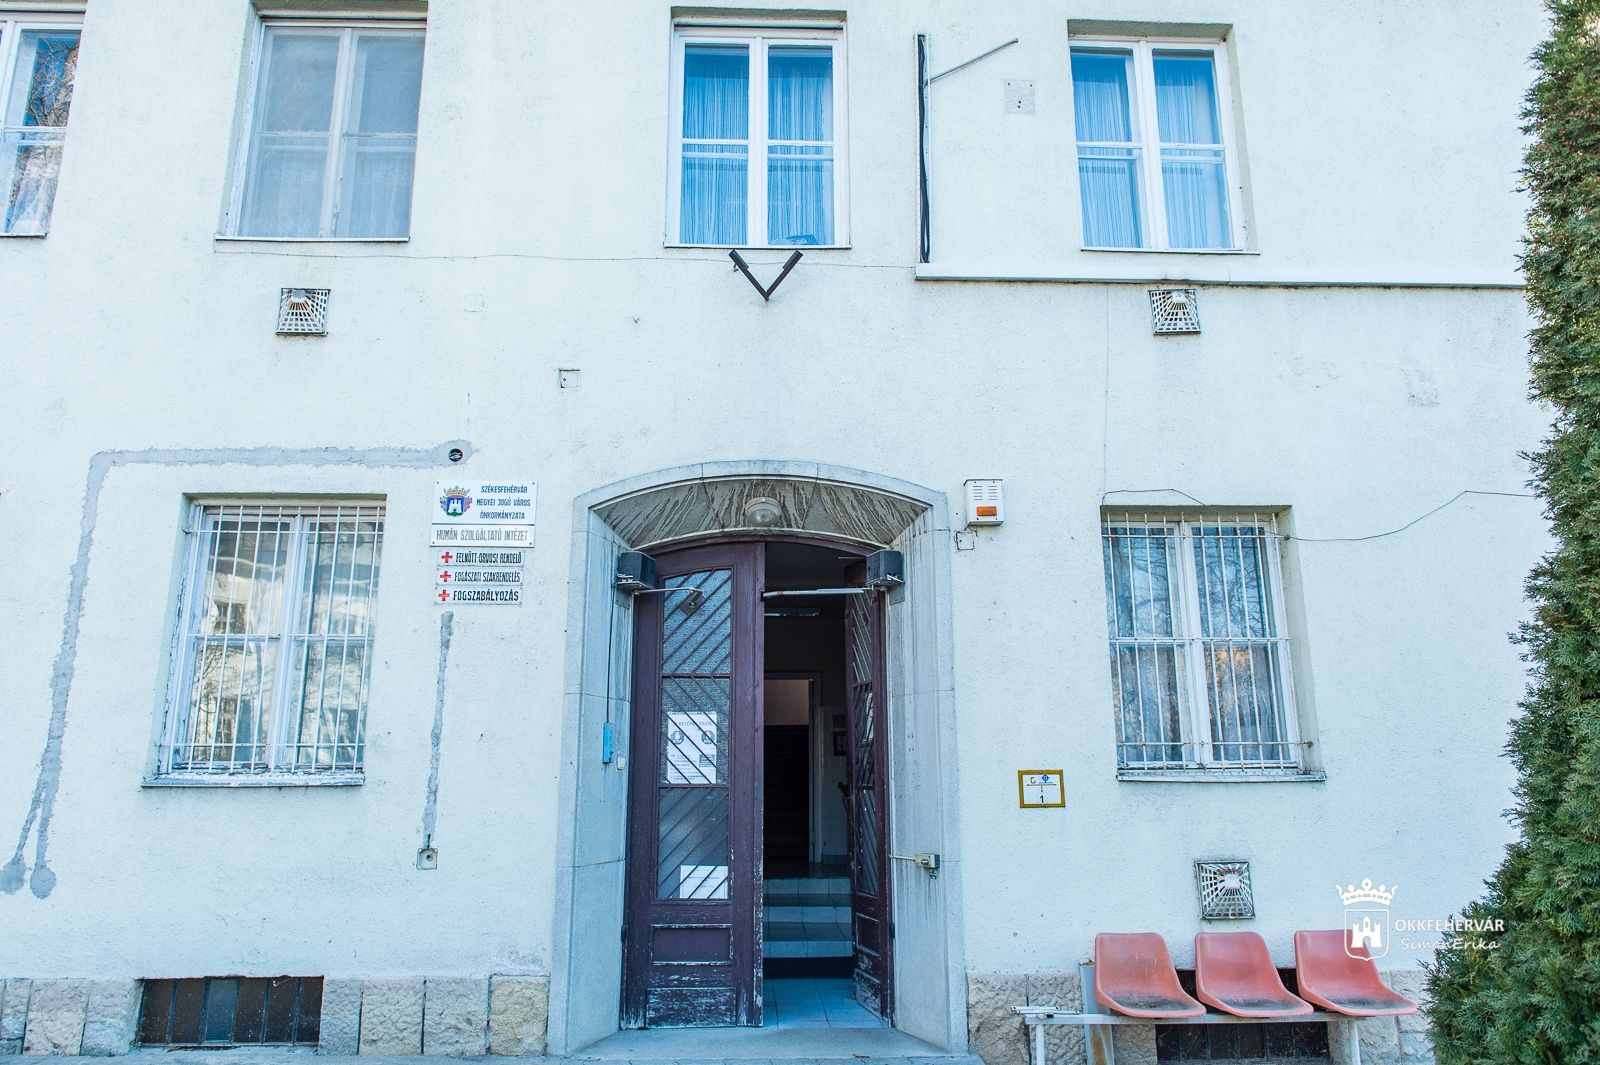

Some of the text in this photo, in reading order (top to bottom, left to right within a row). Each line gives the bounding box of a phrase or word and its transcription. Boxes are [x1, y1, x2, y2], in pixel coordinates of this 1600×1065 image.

[480, 484, 528, 494] SZÉKESFEHÉRVÁR
[476, 497, 531, 507] MEGYEI JOGÚ VÁROS
[479, 510, 525, 520] ÖNKORMÁNYZATA
[436, 528, 529, 541] HUMÁN SZOLGÁLTATÓ INTÉZET
[499, 551, 522, 564] RENDELŐ
[454, 570, 521, 583] FOGÁSZATI SZAKRENDELÉS
[452, 588, 519, 601] FOGSZABÁLYOZÁS
